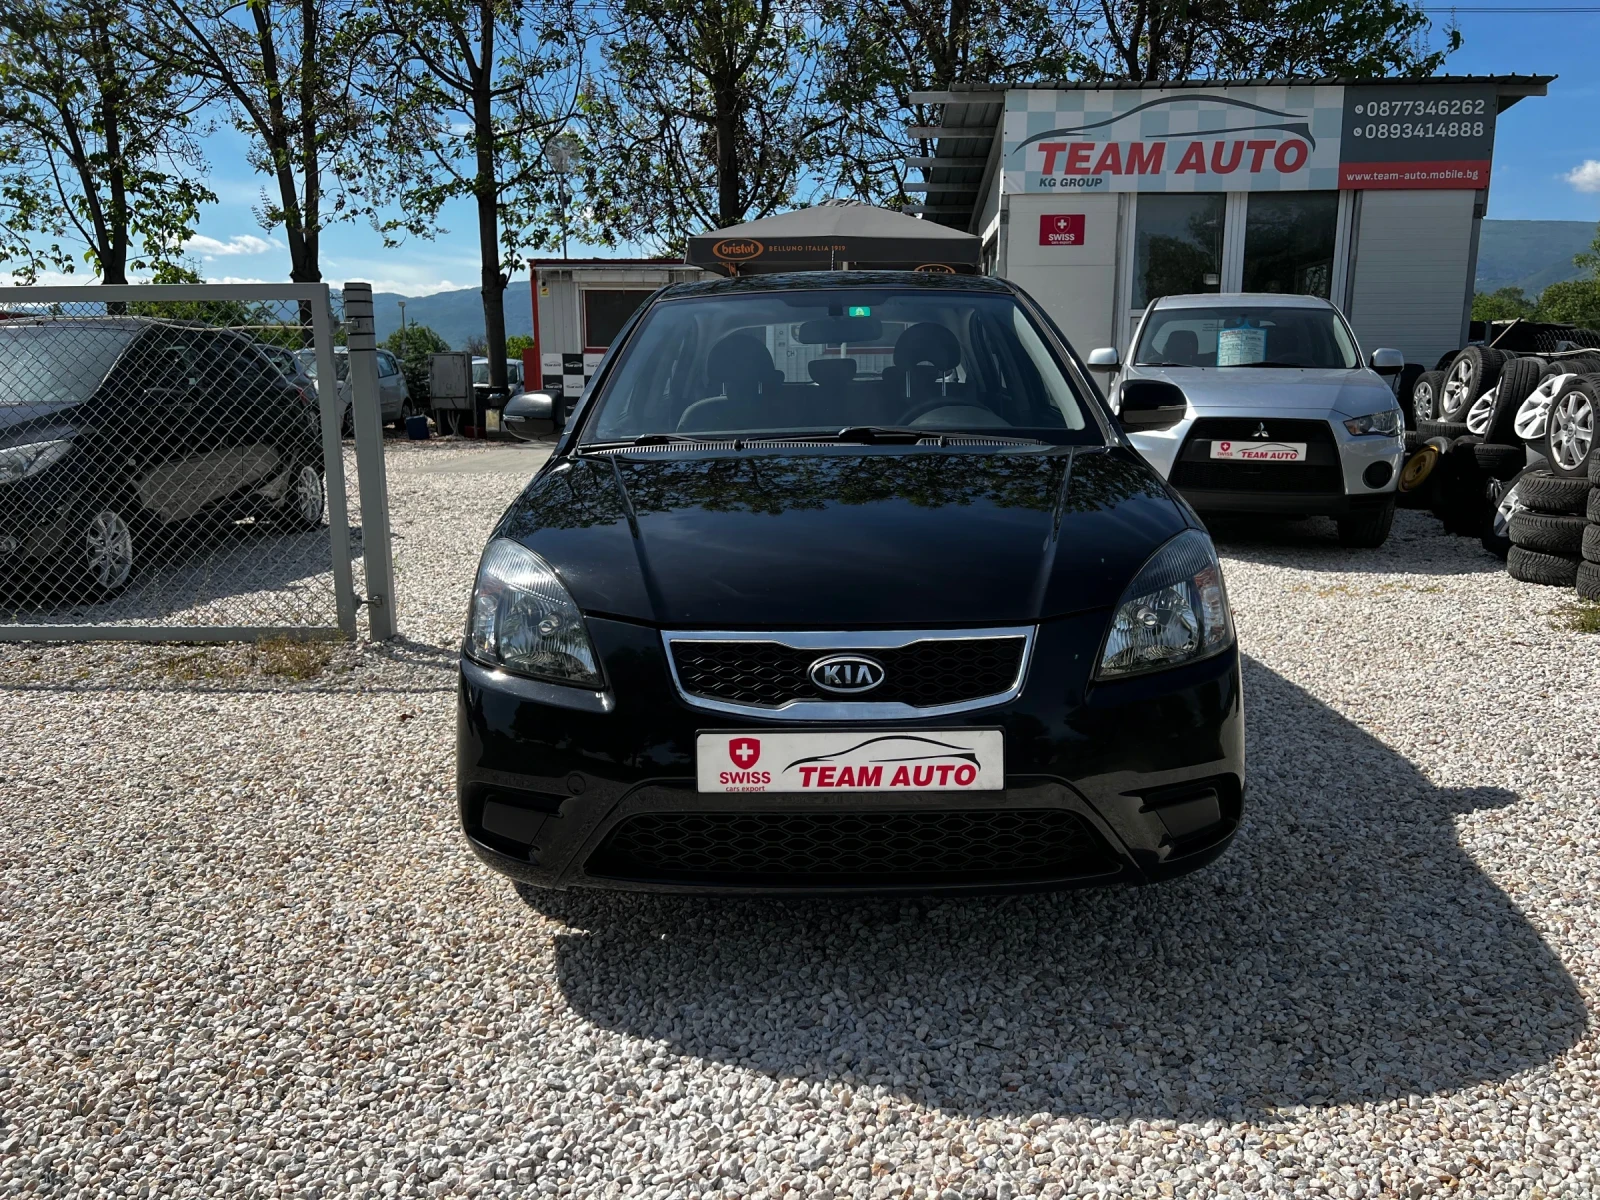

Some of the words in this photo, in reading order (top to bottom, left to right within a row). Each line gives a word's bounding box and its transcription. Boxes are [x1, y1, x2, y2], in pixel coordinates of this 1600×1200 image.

[1366, 99, 1485, 117] 0877346262
[1365, 122, 1484, 139] 0893414888
[1037, 142, 1166, 175] TEAM
[1174, 139, 1308, 174] AUTO
[1039, 178, 1057, 187] KG
[1060, 178, 1103, 187] GROUP
[1346, 169, 1479, 181] www.team-auto.mobile.bg
[1048, 233, 1075, 241] SWISS
[721, 243, 755, 254] bristot
[824, 664, 873, 684] KIA
[719, 771, 771, 784] SWISS
[799, 766, 882, 787] TEAM
[890, 764, 977, 786] AUTO
